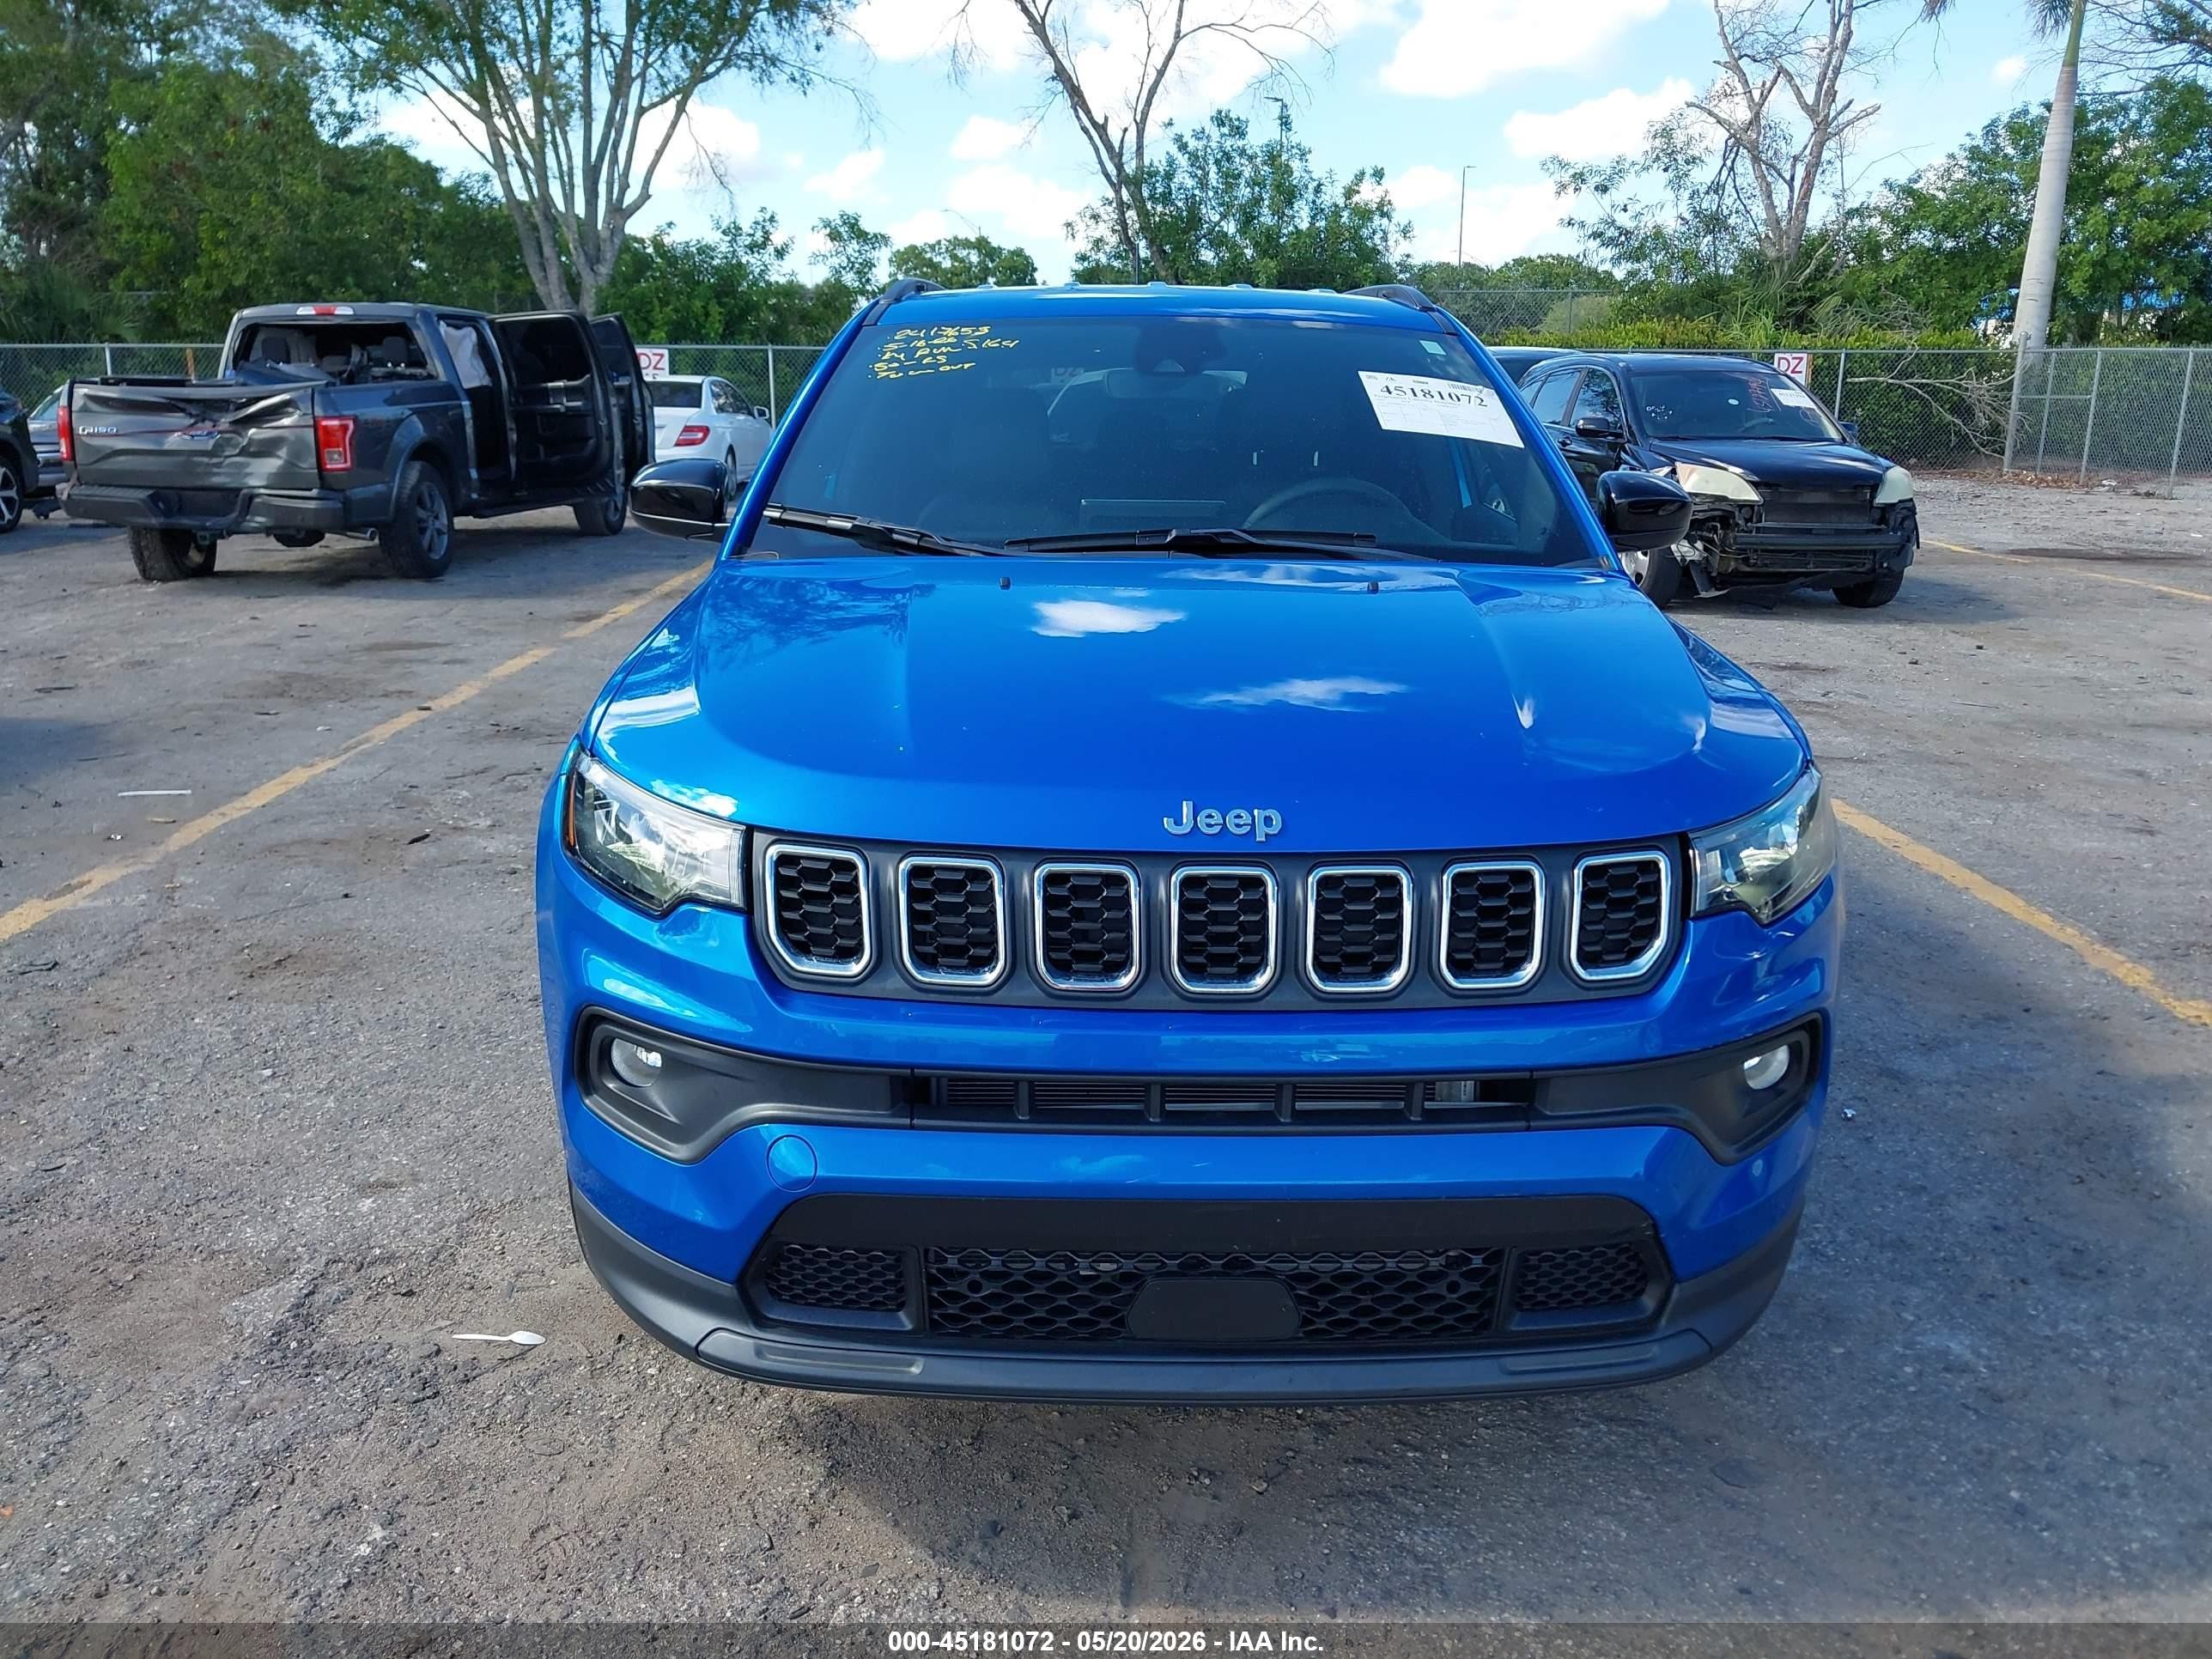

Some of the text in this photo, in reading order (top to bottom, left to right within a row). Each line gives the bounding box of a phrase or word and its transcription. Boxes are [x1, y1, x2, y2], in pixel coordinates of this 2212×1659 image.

[638, 353, 665, 370] DZ
[1778, 356, 1804, 374] DZ
[1380, 385, 1488, 408] 45181072
[1164, 800, 1282, 842] Jeep
